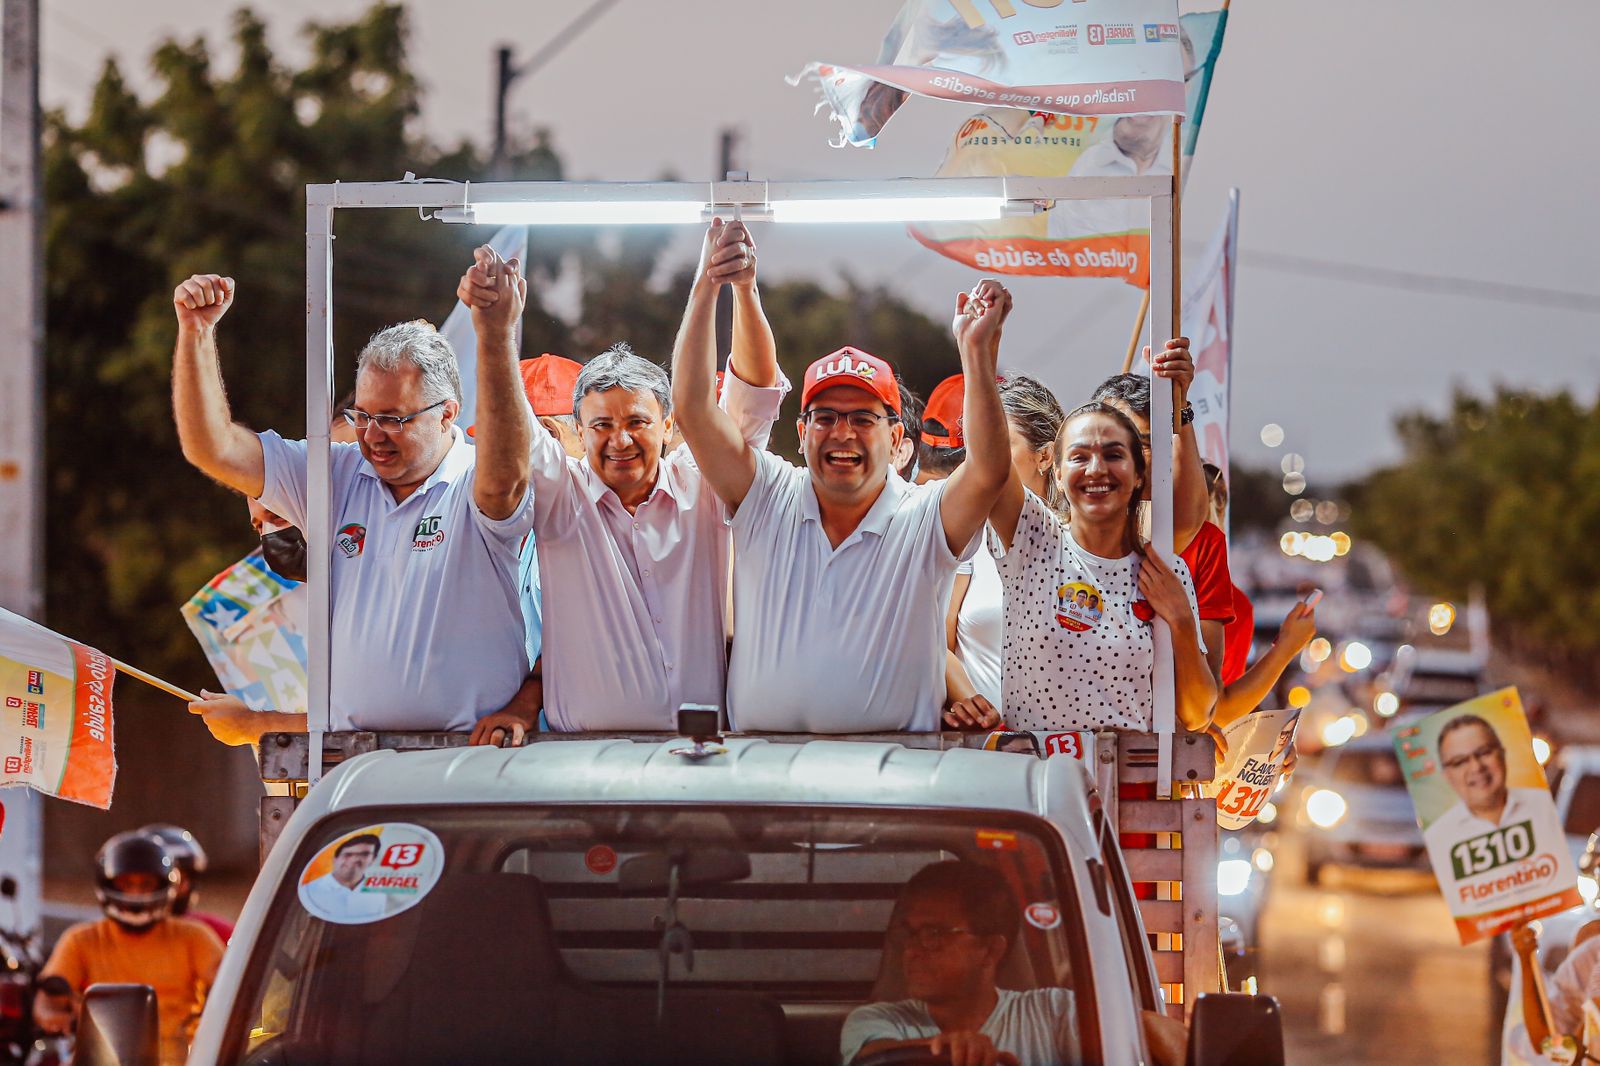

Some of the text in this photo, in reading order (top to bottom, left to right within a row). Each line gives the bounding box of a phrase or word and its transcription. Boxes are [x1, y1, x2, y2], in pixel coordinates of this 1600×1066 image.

[815, 355, 874, 381] LULA
[1049, 734, 1078, 757] 13
[388, 845, 419, 865] 13
[1454, 825, 1530, 876] 1310
[365, 876, 419, 889] RAFAEL
[1458, 862, 1550, 902] Florentino
